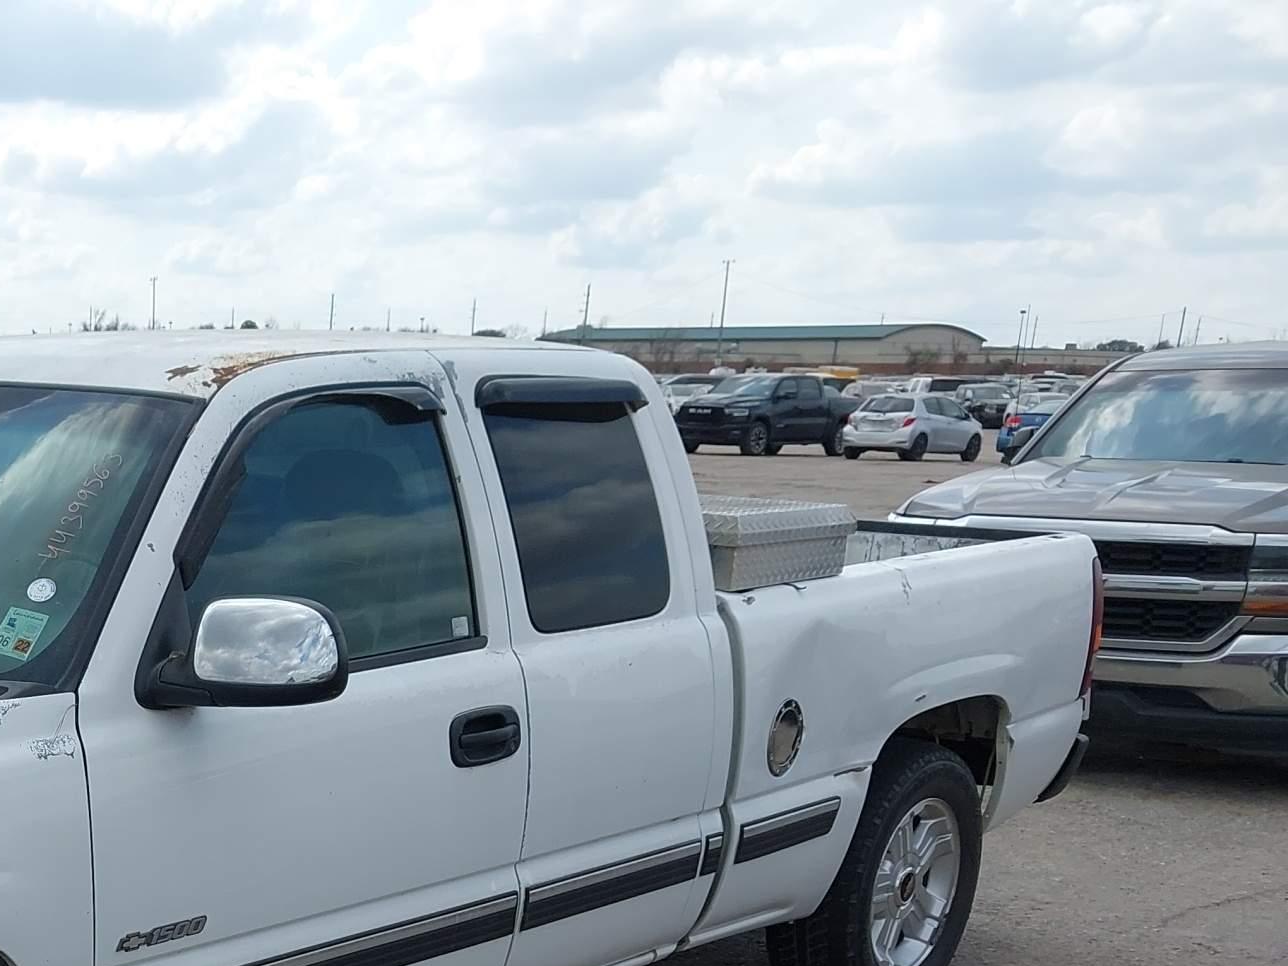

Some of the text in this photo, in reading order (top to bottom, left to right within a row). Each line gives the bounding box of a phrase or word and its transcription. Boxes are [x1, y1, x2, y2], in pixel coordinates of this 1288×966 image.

[37, 454, 123, 560] 44399563
[14, 639, 31, 654] 22
[150, 914, 208, 946] 1500
